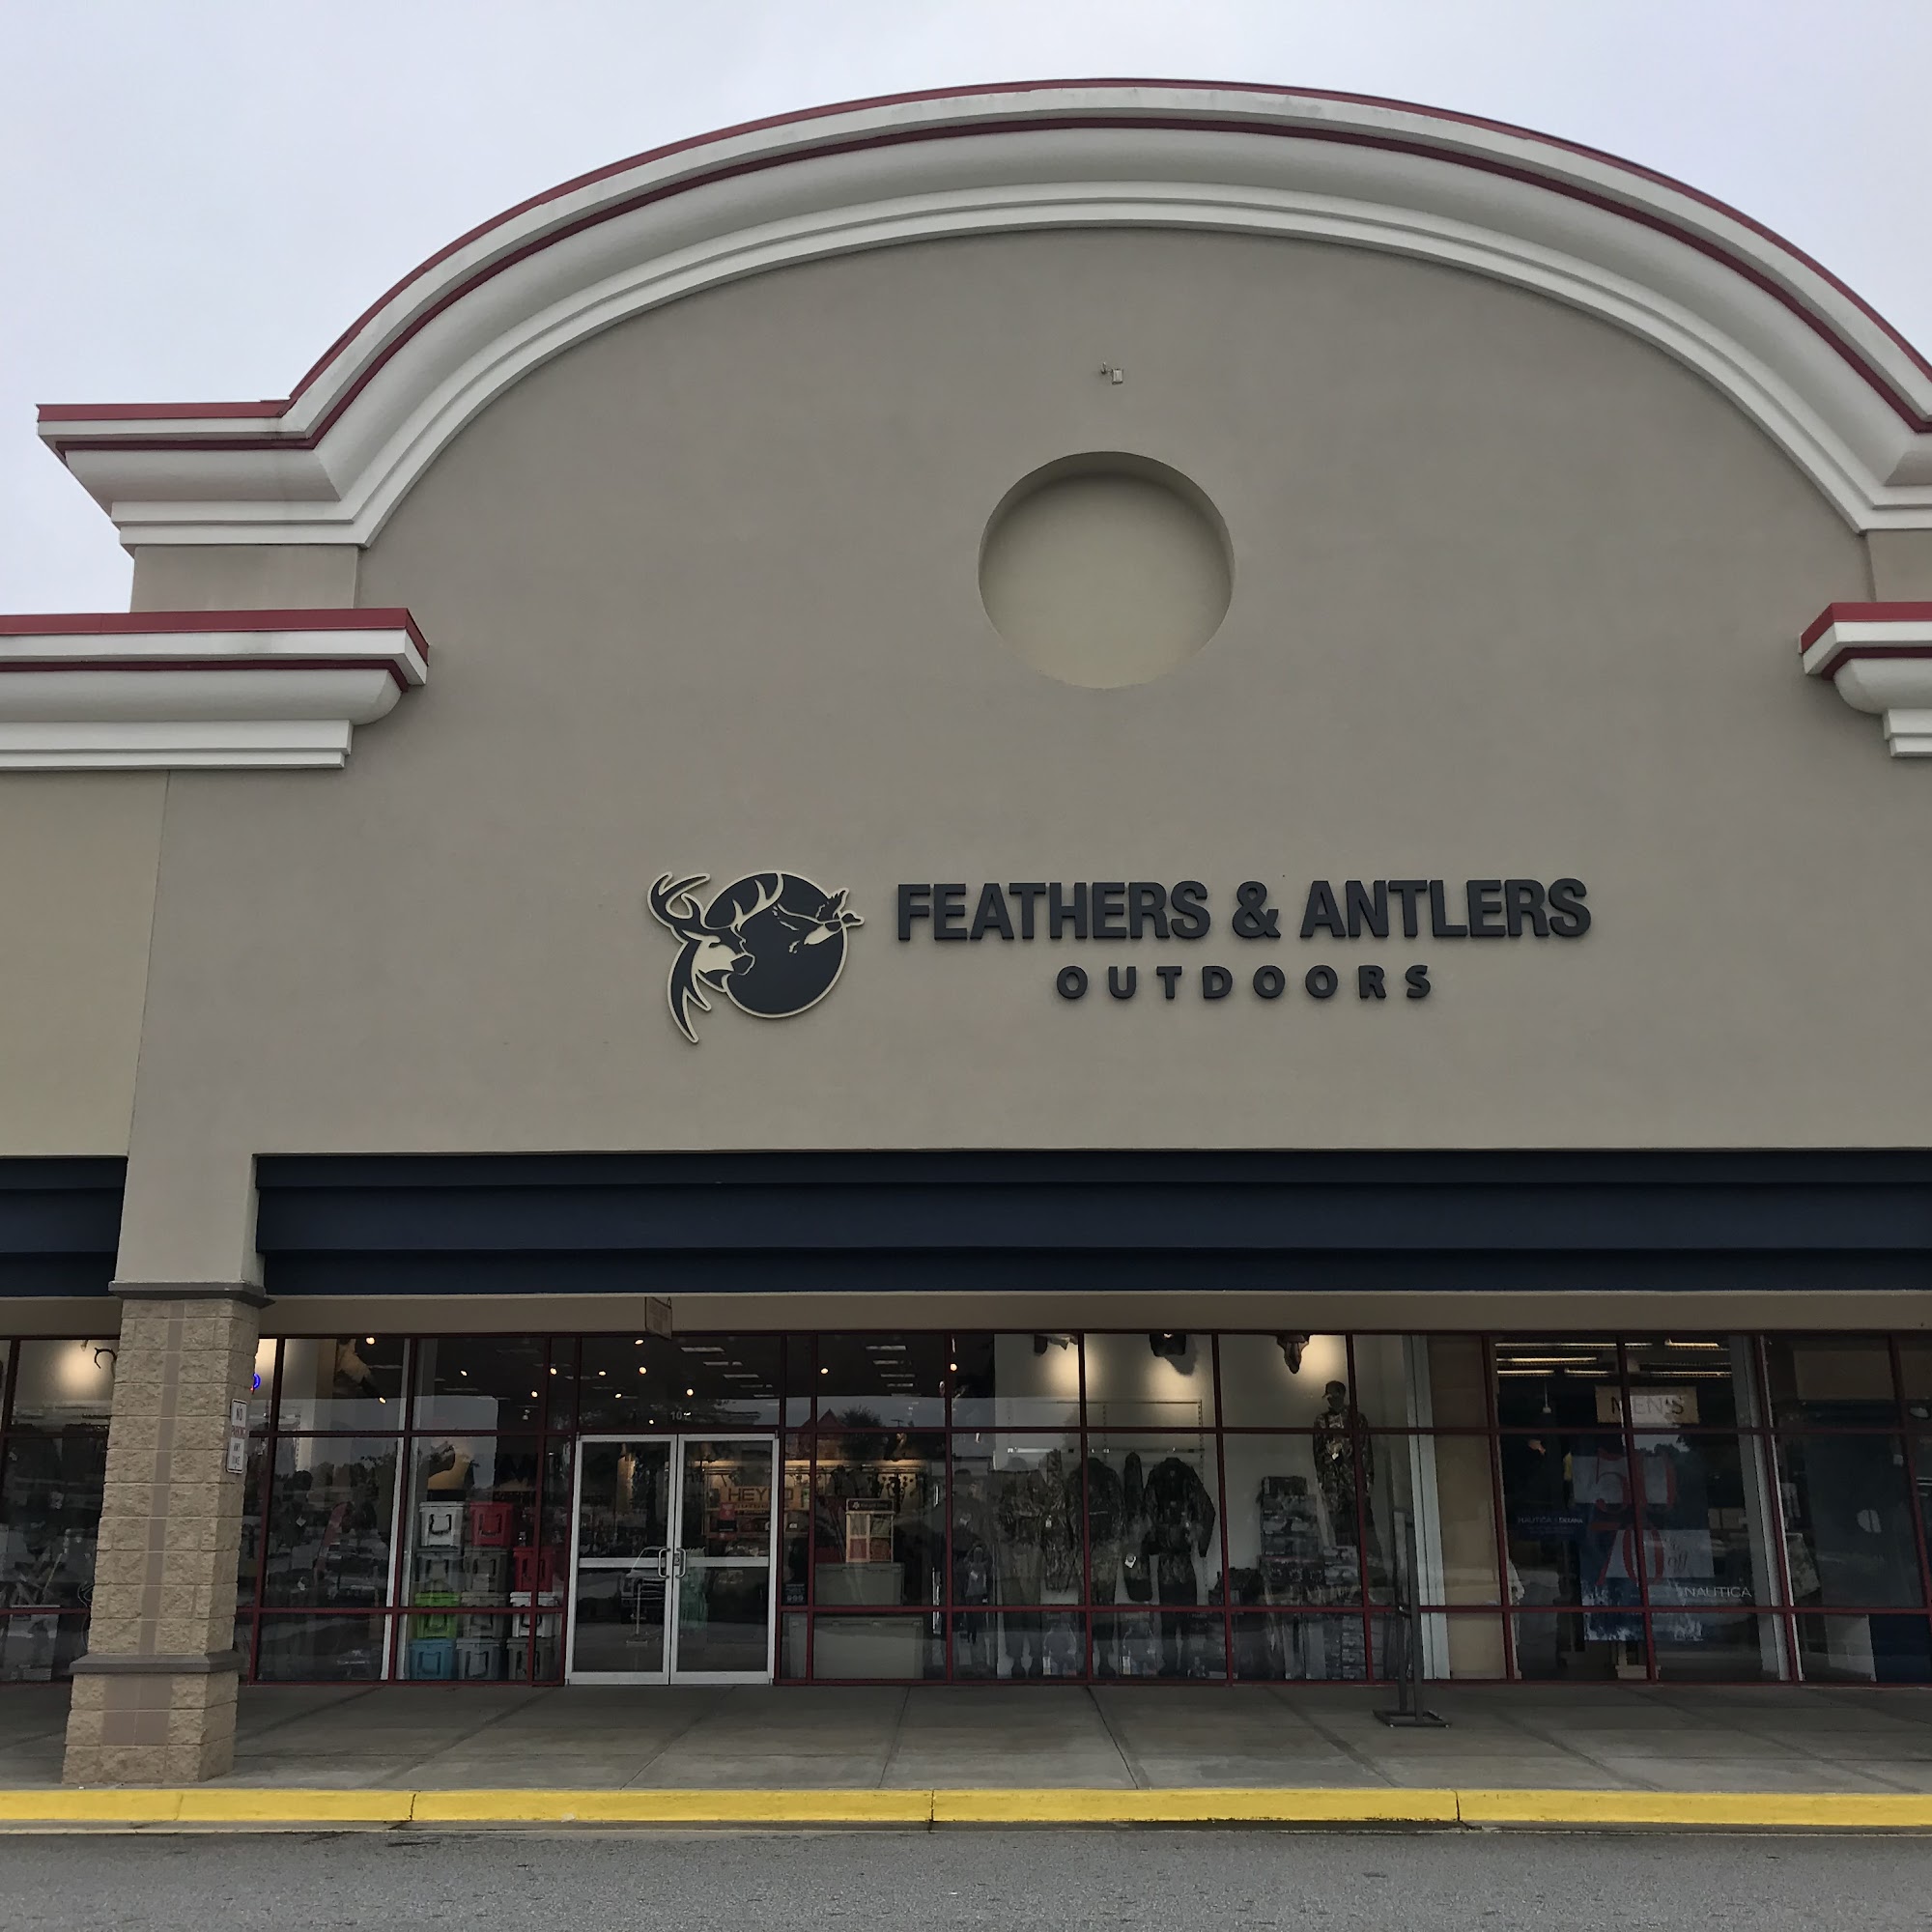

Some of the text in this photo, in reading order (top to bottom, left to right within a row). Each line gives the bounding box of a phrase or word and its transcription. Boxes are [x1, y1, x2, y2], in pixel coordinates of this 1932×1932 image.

[897, 877, 1592, 942] FEATHERS & ANTLERS
[1056, 965, 1432, 1001] OUTDOORS
[1684, 1586, 1752, 1598] NAUTICA
